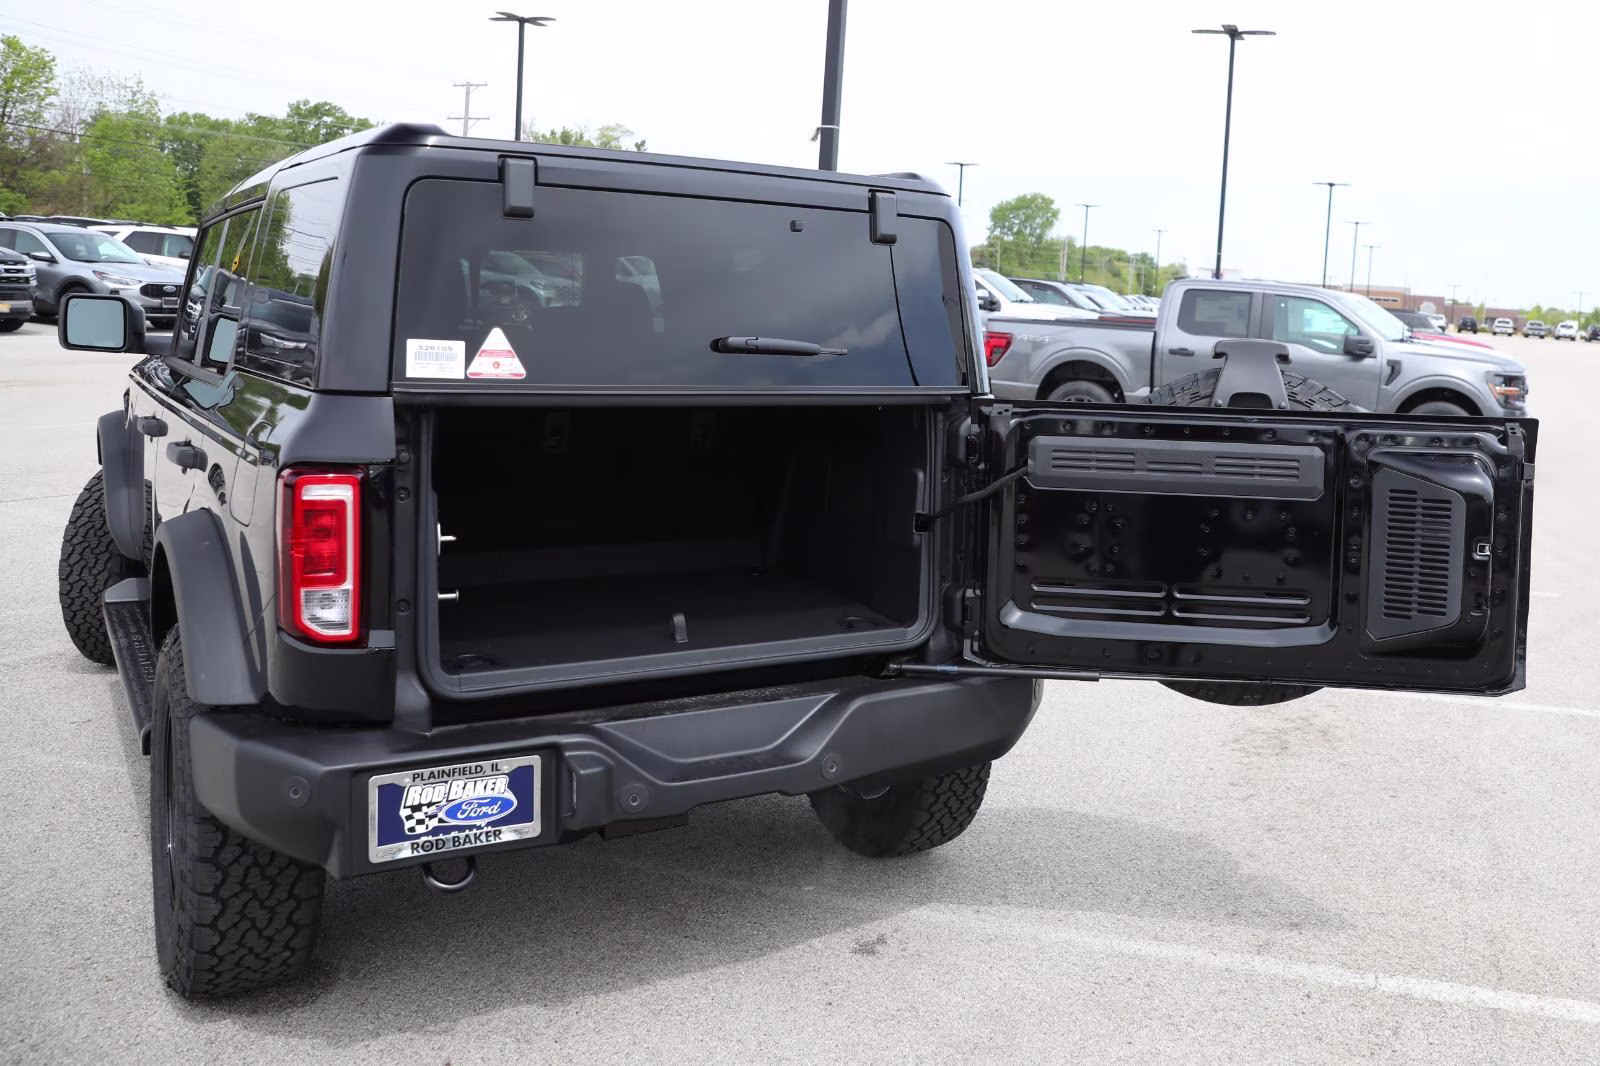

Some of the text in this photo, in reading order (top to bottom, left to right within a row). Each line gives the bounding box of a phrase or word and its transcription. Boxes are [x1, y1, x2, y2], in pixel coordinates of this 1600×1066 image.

[412, 762, 501, 782] PLAINFIELD, IL
[405, 777, 507, 806] ROD BAKER
[456, 798, 501, 819] Ford
[410, 839, 446, 854] ROD
[452, 829, 502, 849] BAKER
